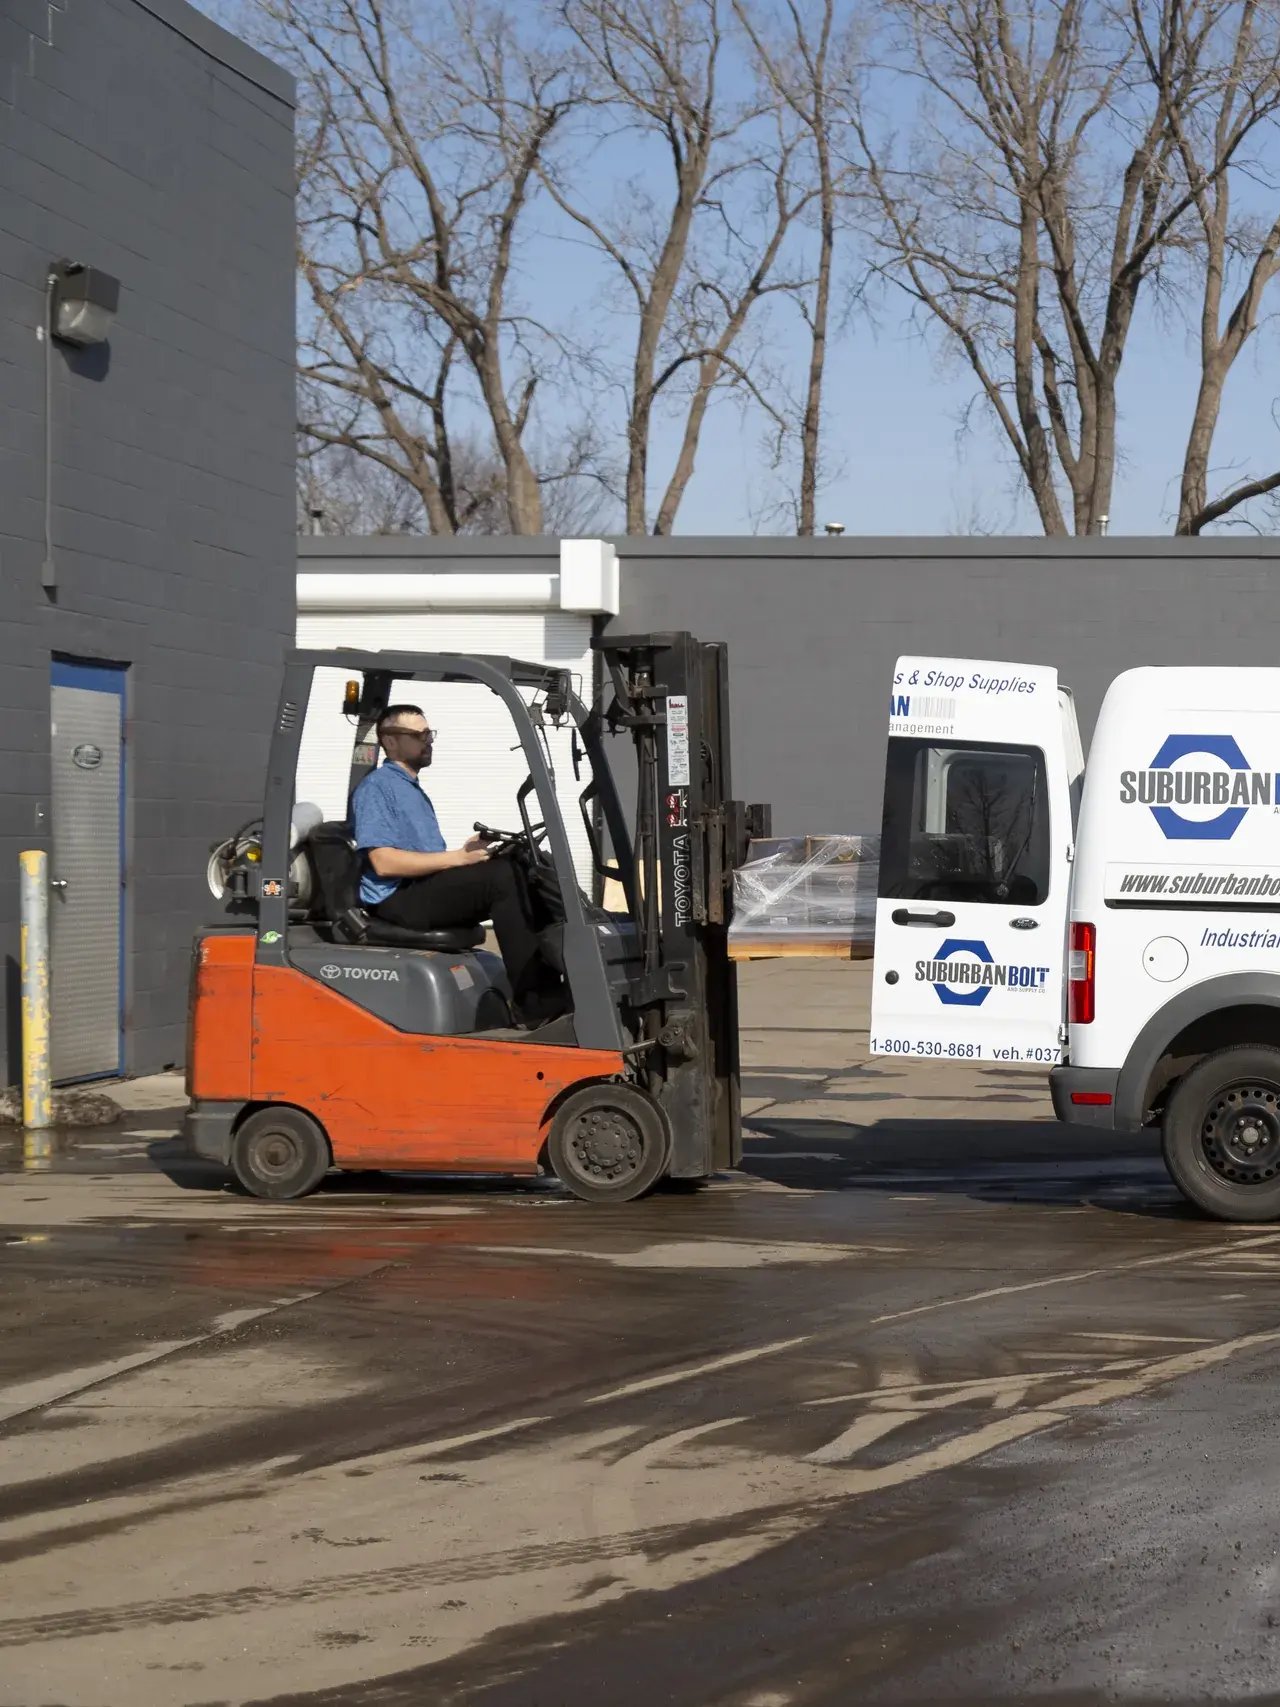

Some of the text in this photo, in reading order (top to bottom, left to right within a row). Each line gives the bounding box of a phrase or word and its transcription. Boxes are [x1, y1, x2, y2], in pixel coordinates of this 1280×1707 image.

[908, 669, 920, 685] &
[924, 670, 965, 691] Shop
[968, 673, 1037, 694] Supplies
[673, 833, 692, 927] TOYOTA
[343, 967, 400, 982] TOYOTA
[871, 1038, 982, 1058] 1-800-530-8681
